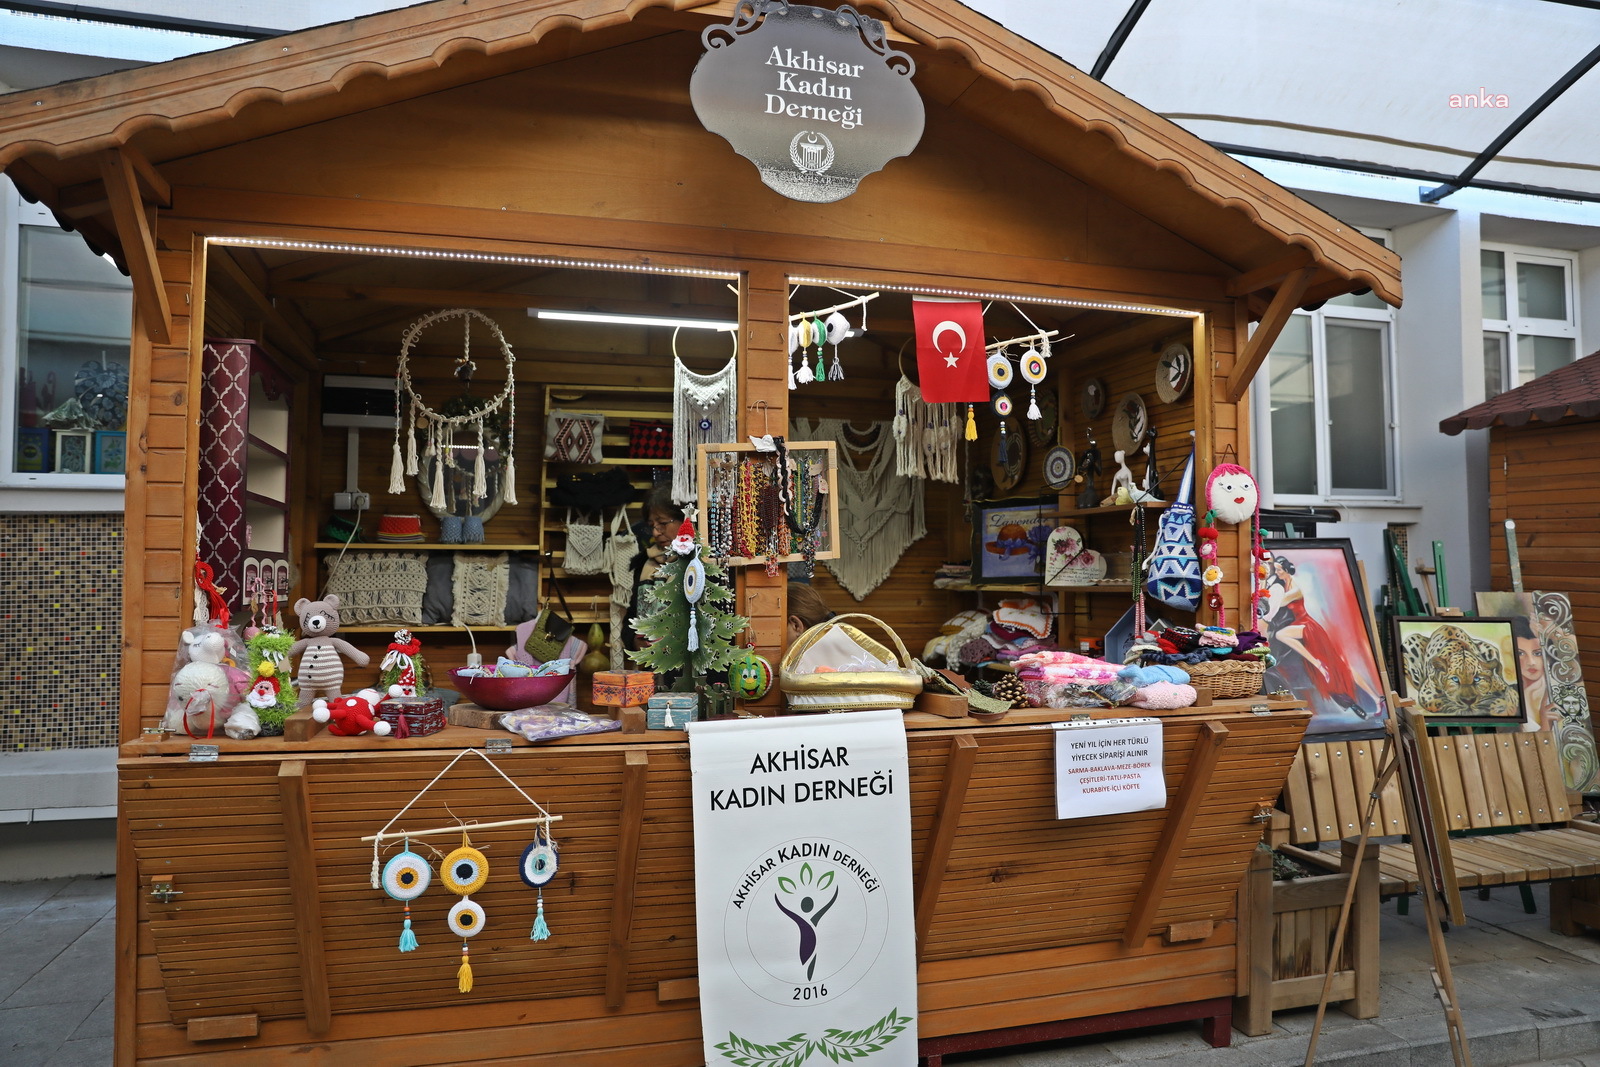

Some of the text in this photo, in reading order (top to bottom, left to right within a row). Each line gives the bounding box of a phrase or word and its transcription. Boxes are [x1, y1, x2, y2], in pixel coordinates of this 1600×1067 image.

[765, 45, 864, 78] Akhisar
[777, 71, 852, 100] Kadın
[764, 93, 864, 130] Derneği
[1070, 740, 1086, 749] YENİ
[1098, 739, 1112, 748] İÇİN
[1127, 736, 1149, 745] TÜRLÜ
[1071, 749, 1148, 761] YİYECEK SİPARİŞİ ALINIR
[750, 744, 849, 774] AKHİSAR
[710, 769, 893, 811] KADIN DERNEĞİ
[1122, 783, 1141, 791] KÖFTE
[733, 843, 880, 909] AKHİSAR KADIN DERNEĞİ
[792, 983, 828, 1001] 2016
